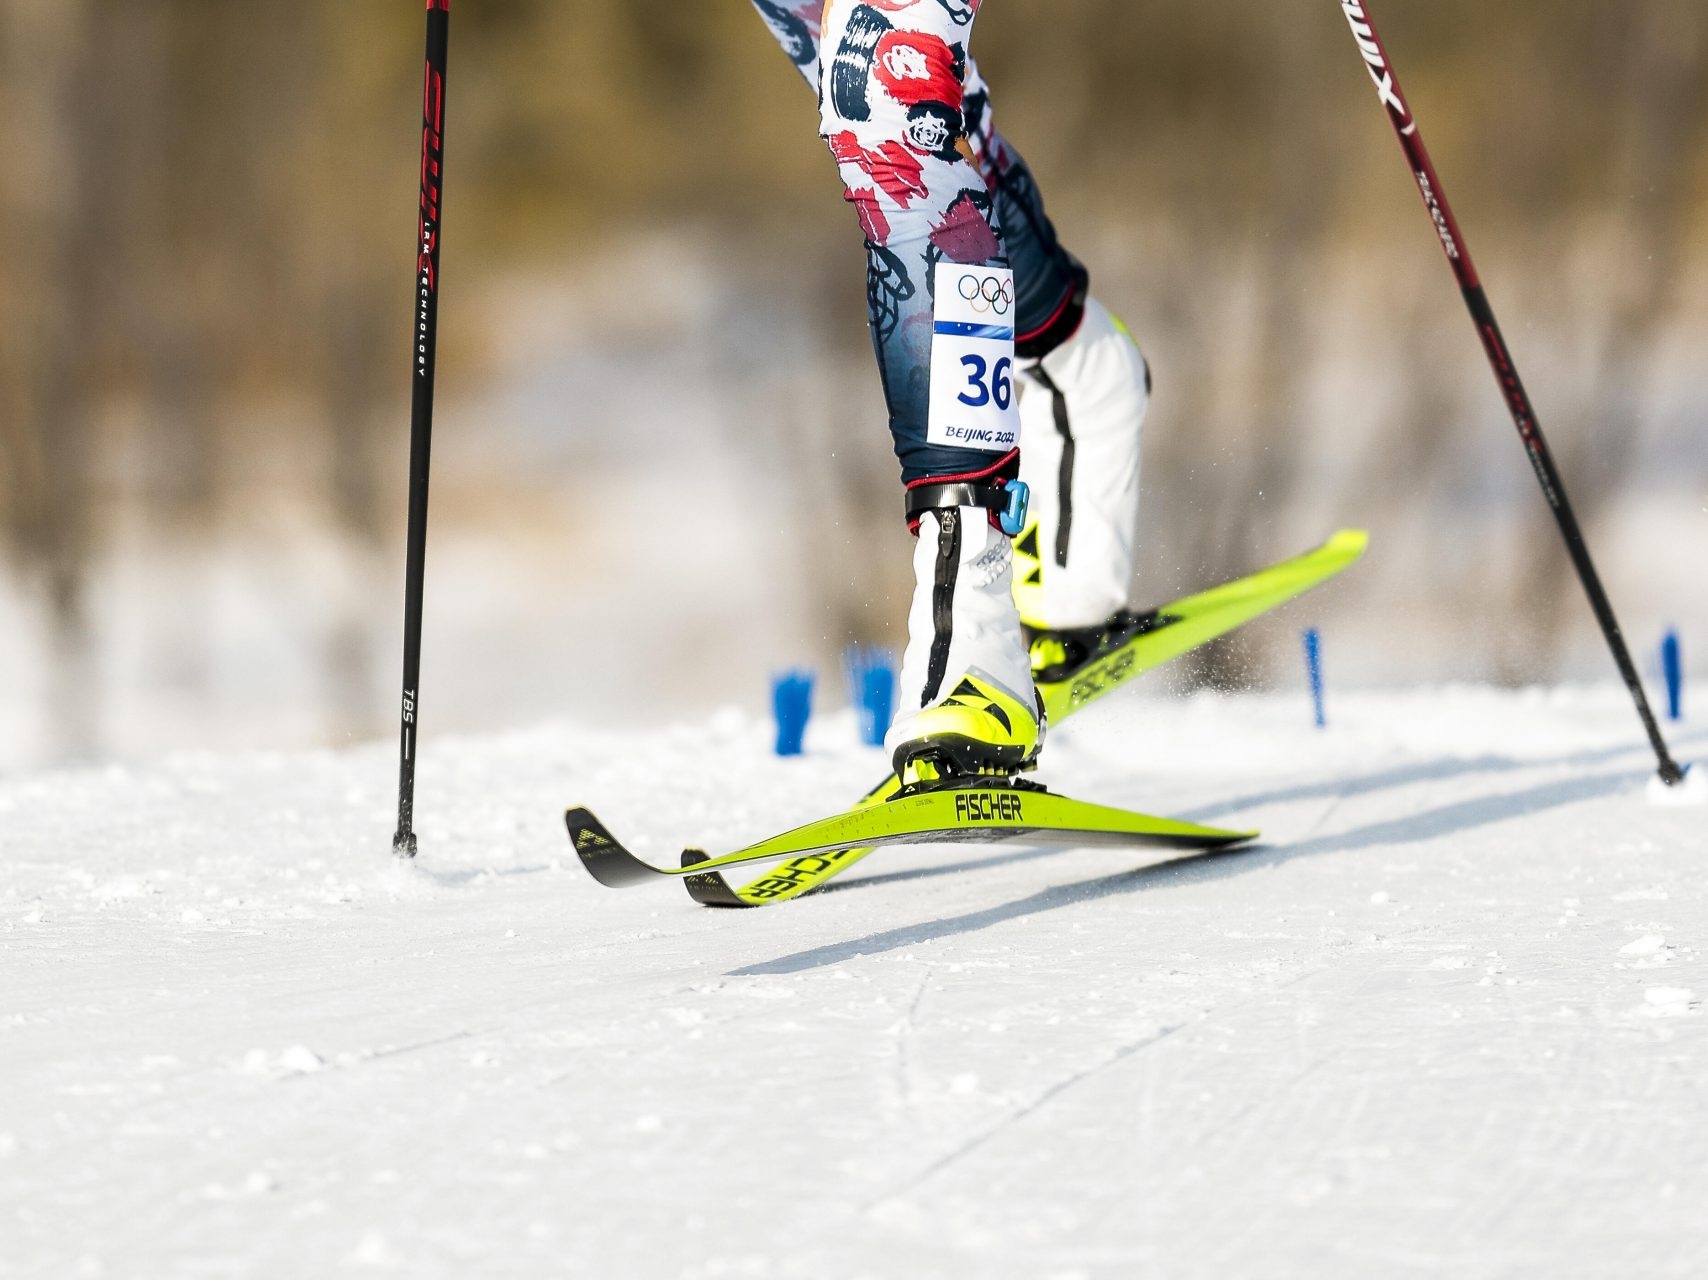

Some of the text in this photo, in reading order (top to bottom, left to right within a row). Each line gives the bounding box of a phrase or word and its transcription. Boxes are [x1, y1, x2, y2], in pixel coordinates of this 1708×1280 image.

[418, 60, 441, 292] SWIX
[418, 266, 429, 376] TECHNOLOGY
[957, 354, 1012, 411] 36
[945, 426, 1015, 444] BEIJING 2022
[955, 793, 1023, 821] FISCHER
